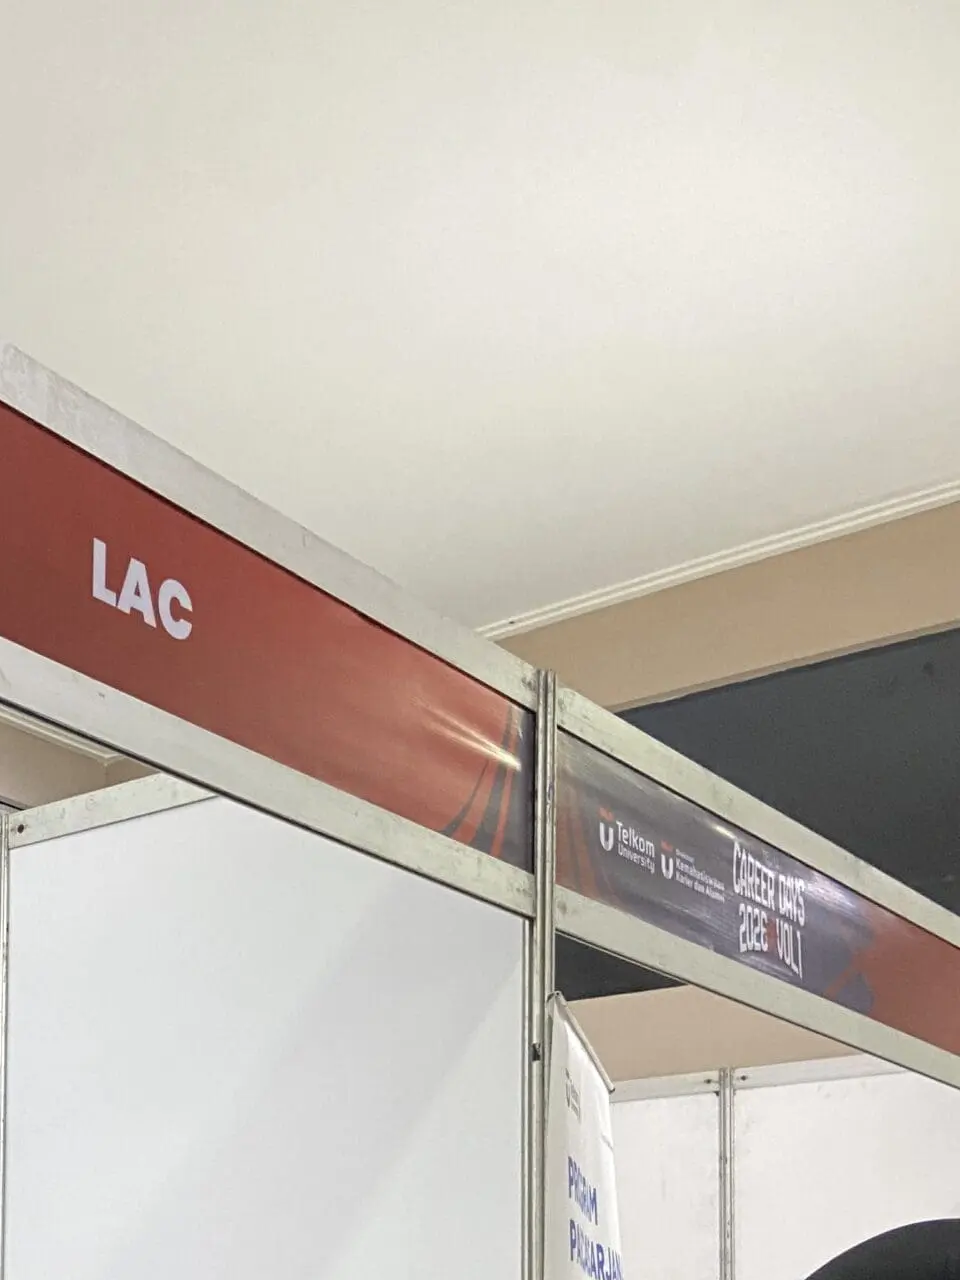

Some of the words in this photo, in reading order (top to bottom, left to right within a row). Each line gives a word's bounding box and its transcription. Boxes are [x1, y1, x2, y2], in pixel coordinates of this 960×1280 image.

[92, 537, 193, 640] LAC
[615, 820, 656, 858] Telkom
[617, 842, 656, 875] University
[732, 840, 776, 911] CAREER
[778, 873, 805, 928] DAYS
